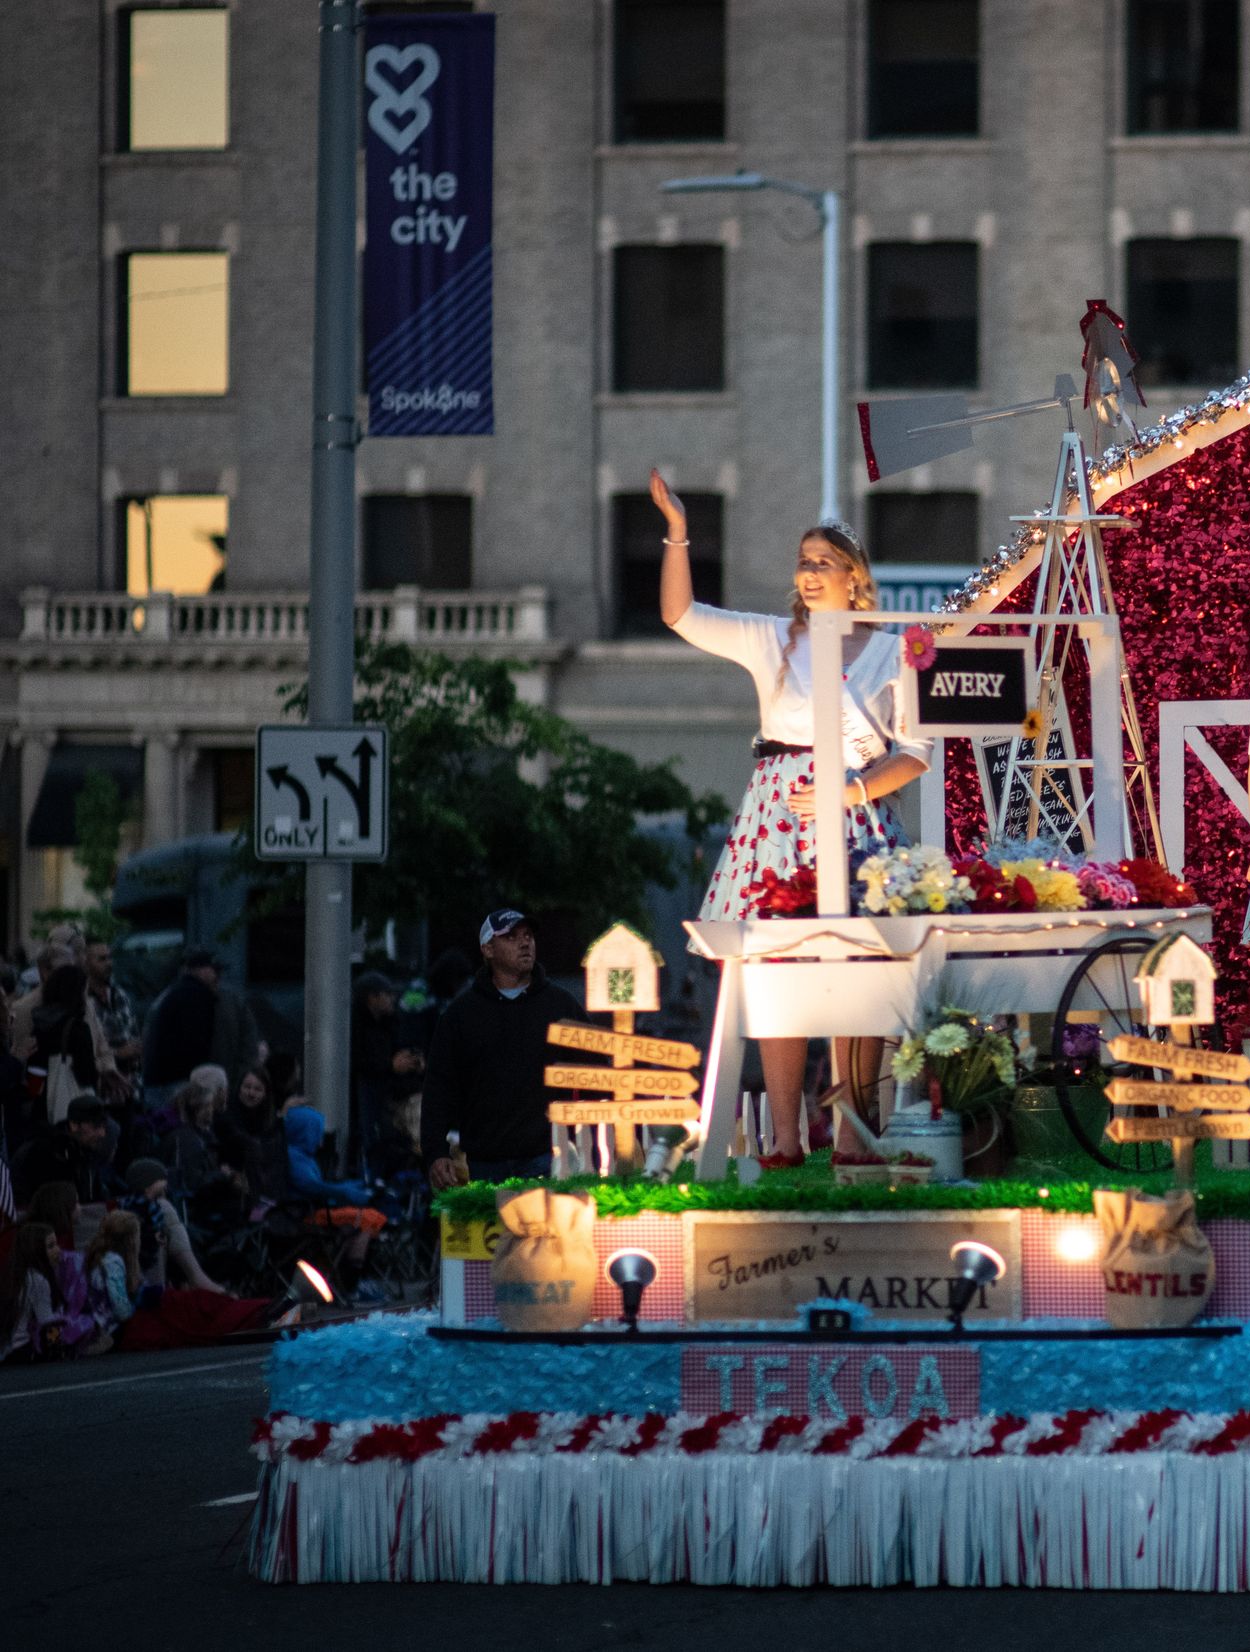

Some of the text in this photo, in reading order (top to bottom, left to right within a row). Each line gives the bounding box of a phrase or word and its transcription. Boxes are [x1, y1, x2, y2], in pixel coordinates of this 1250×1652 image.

[389, 162, 458, 201] the
[390, 204, 468, 254] city
[930, 672, 1005, 698] AVERY
[264, 825, 319, 848] ONLY
[559, 1027, 682, 1063] FARM FRESH
[1125, 1039, 1239, 1073] FARM FRESH
[553, 1070, 682, 1091] ORGANIC FOOD
[1199, 1087, 1242, 1104] FOOD
[561, 1104, 687, 1122] Farm Grown
[1183, 1117, 1244, 1137] Grown
[707, 1225, 840, 1291] Farmer's
[1104, 1271, 1207, 1298] LENTILS
[705, 1354, 950, 1421] TEKOA
